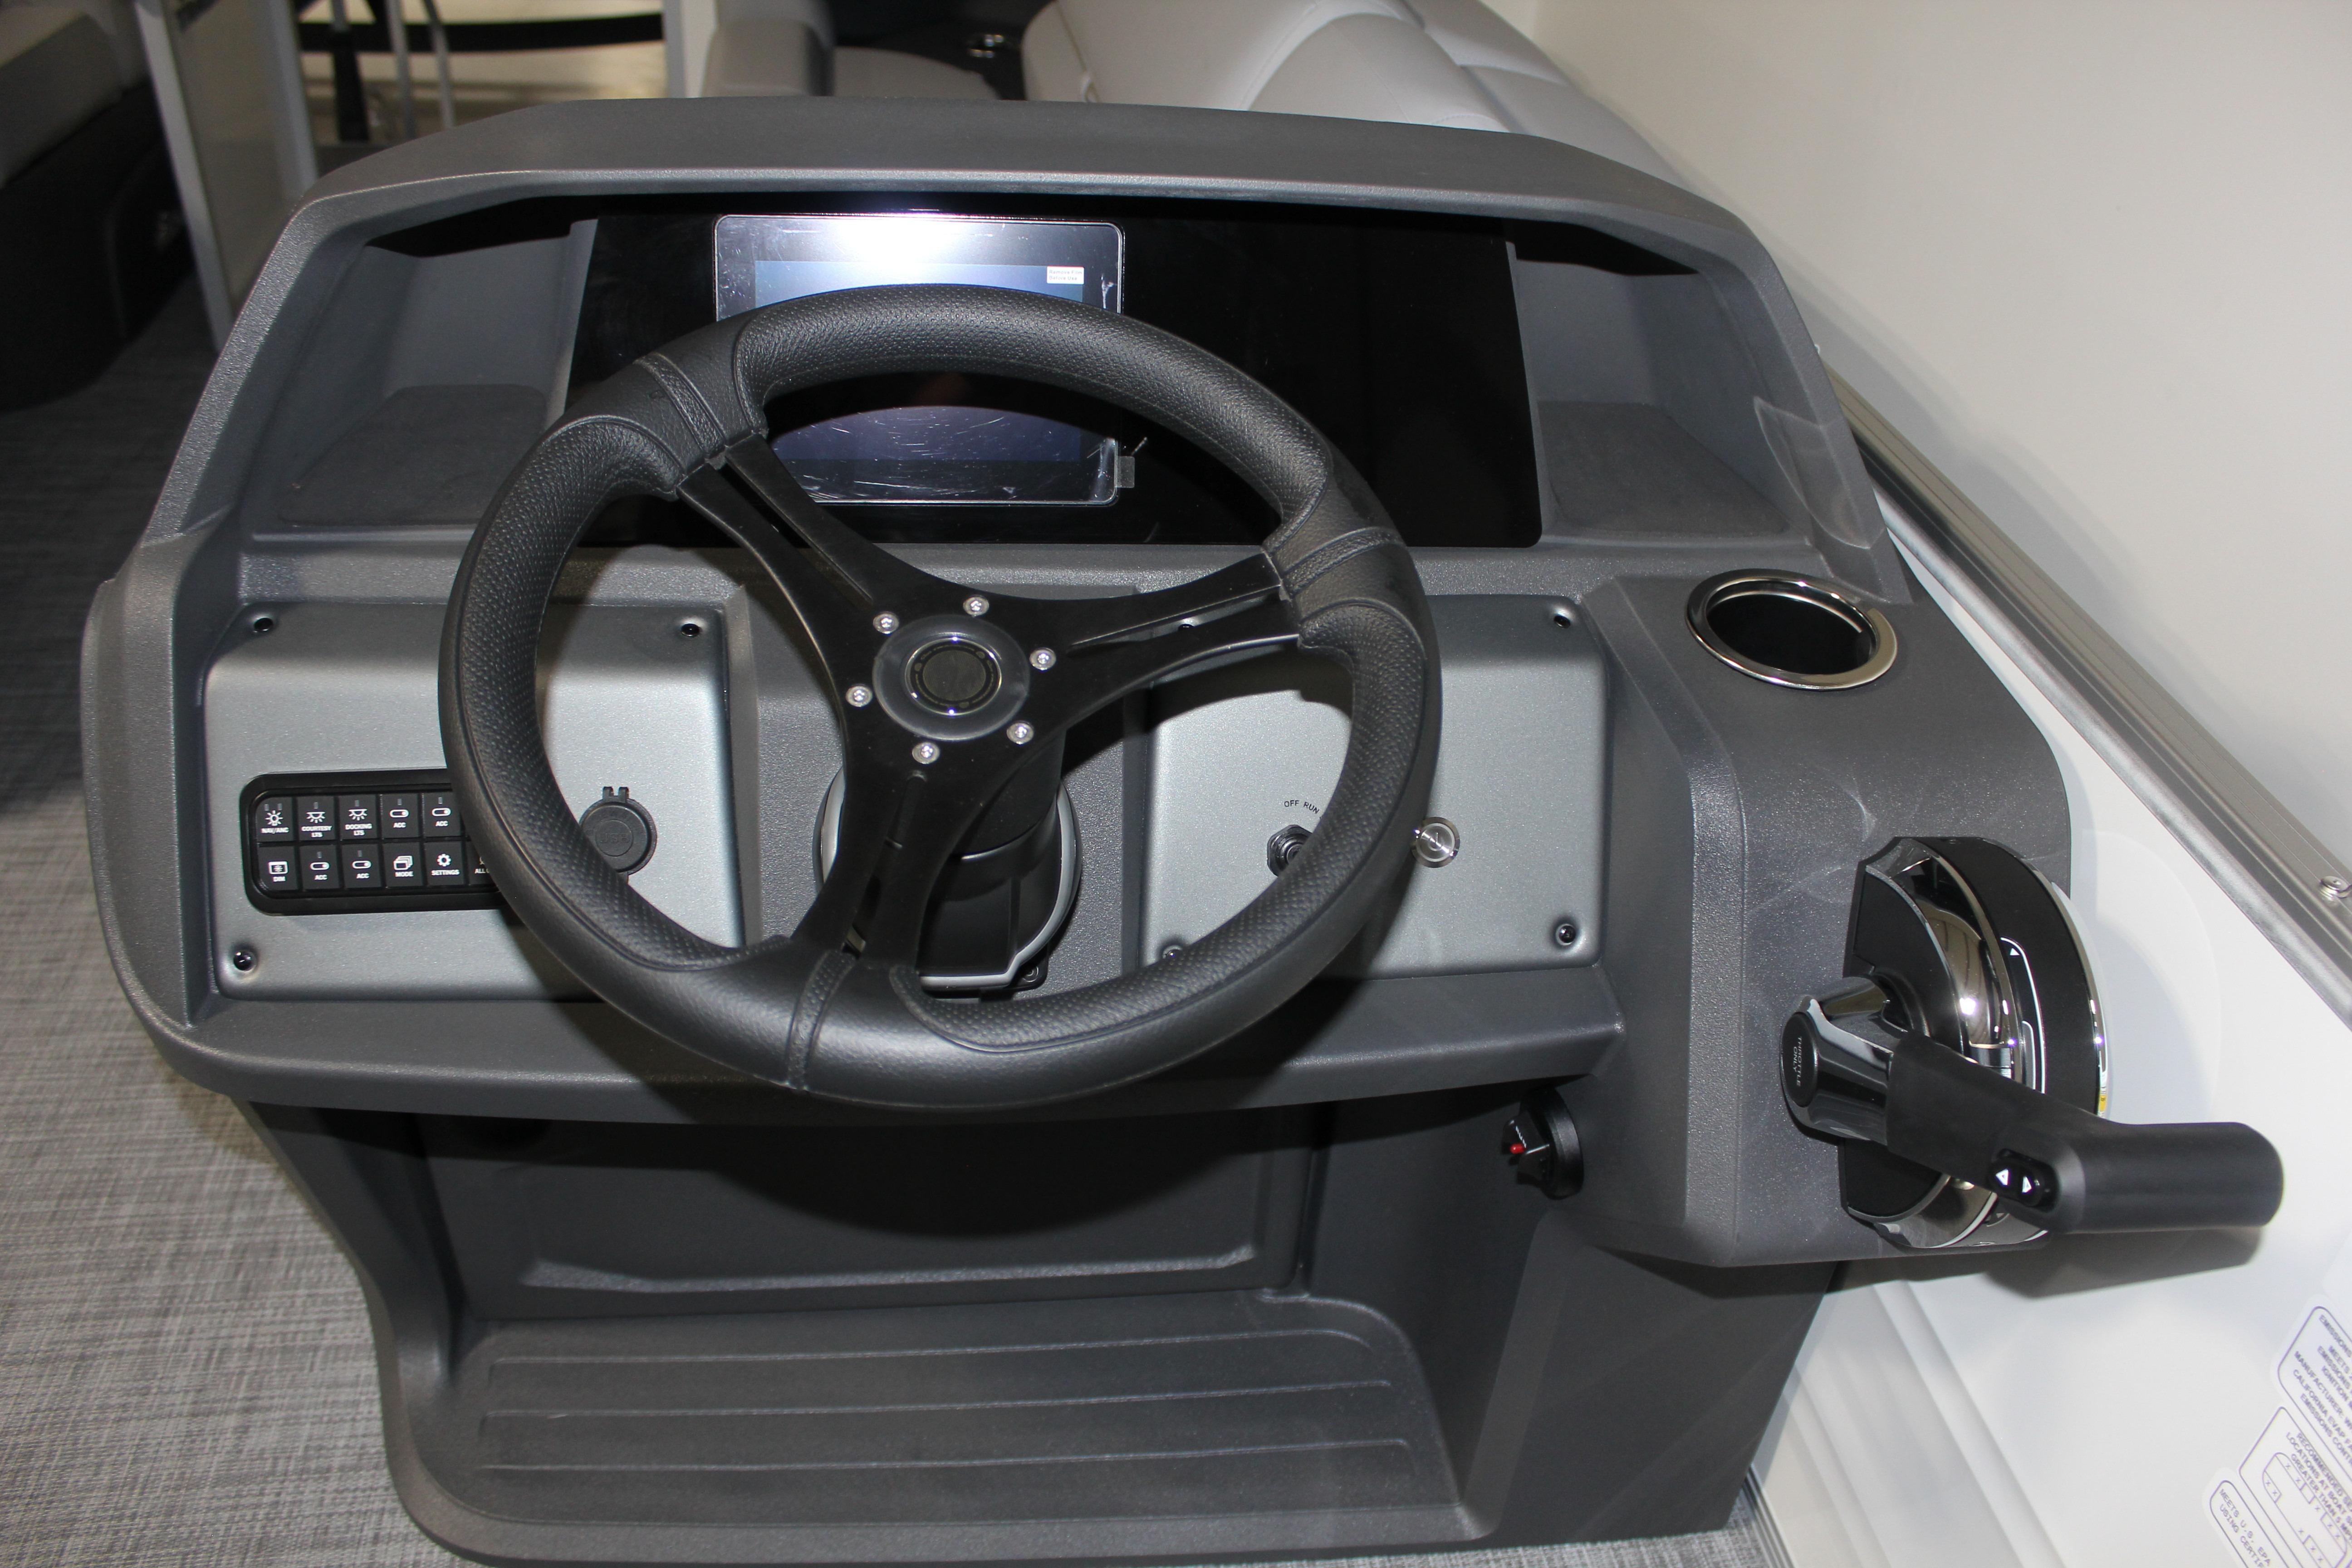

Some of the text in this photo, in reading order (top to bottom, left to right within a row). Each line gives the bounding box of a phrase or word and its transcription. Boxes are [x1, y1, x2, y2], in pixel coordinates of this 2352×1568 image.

[1303, 801, 1320, 814] RUN
[2319, 1314, 2352, 1357] EMISSIONS
[2318, 1346, 2351, 1389] EMISSIONS
[2328, 1345, 2350, 1374] MEETS
[2293, 1369, 2328, 1416] CALIFORNIA
[2328, 1416, 2345, 1437] EVAP
[2300, 1393, 2332, 1437] EMISSIONS
[2286, 1432, 2347, 1514] LOCATIONS AT BOAT
[2291, 1453, 2319, 1492] GREATER
[2319, 1493, 2337, 1516] THAN
[2297, 1432, 2342, 1496] RECOMMENDED
[2220, 1504, 2239, 1533] USING
[2220, 1489, 2239, 1518] MEETS
[2258, 1546, 2270, 1566] EPA
